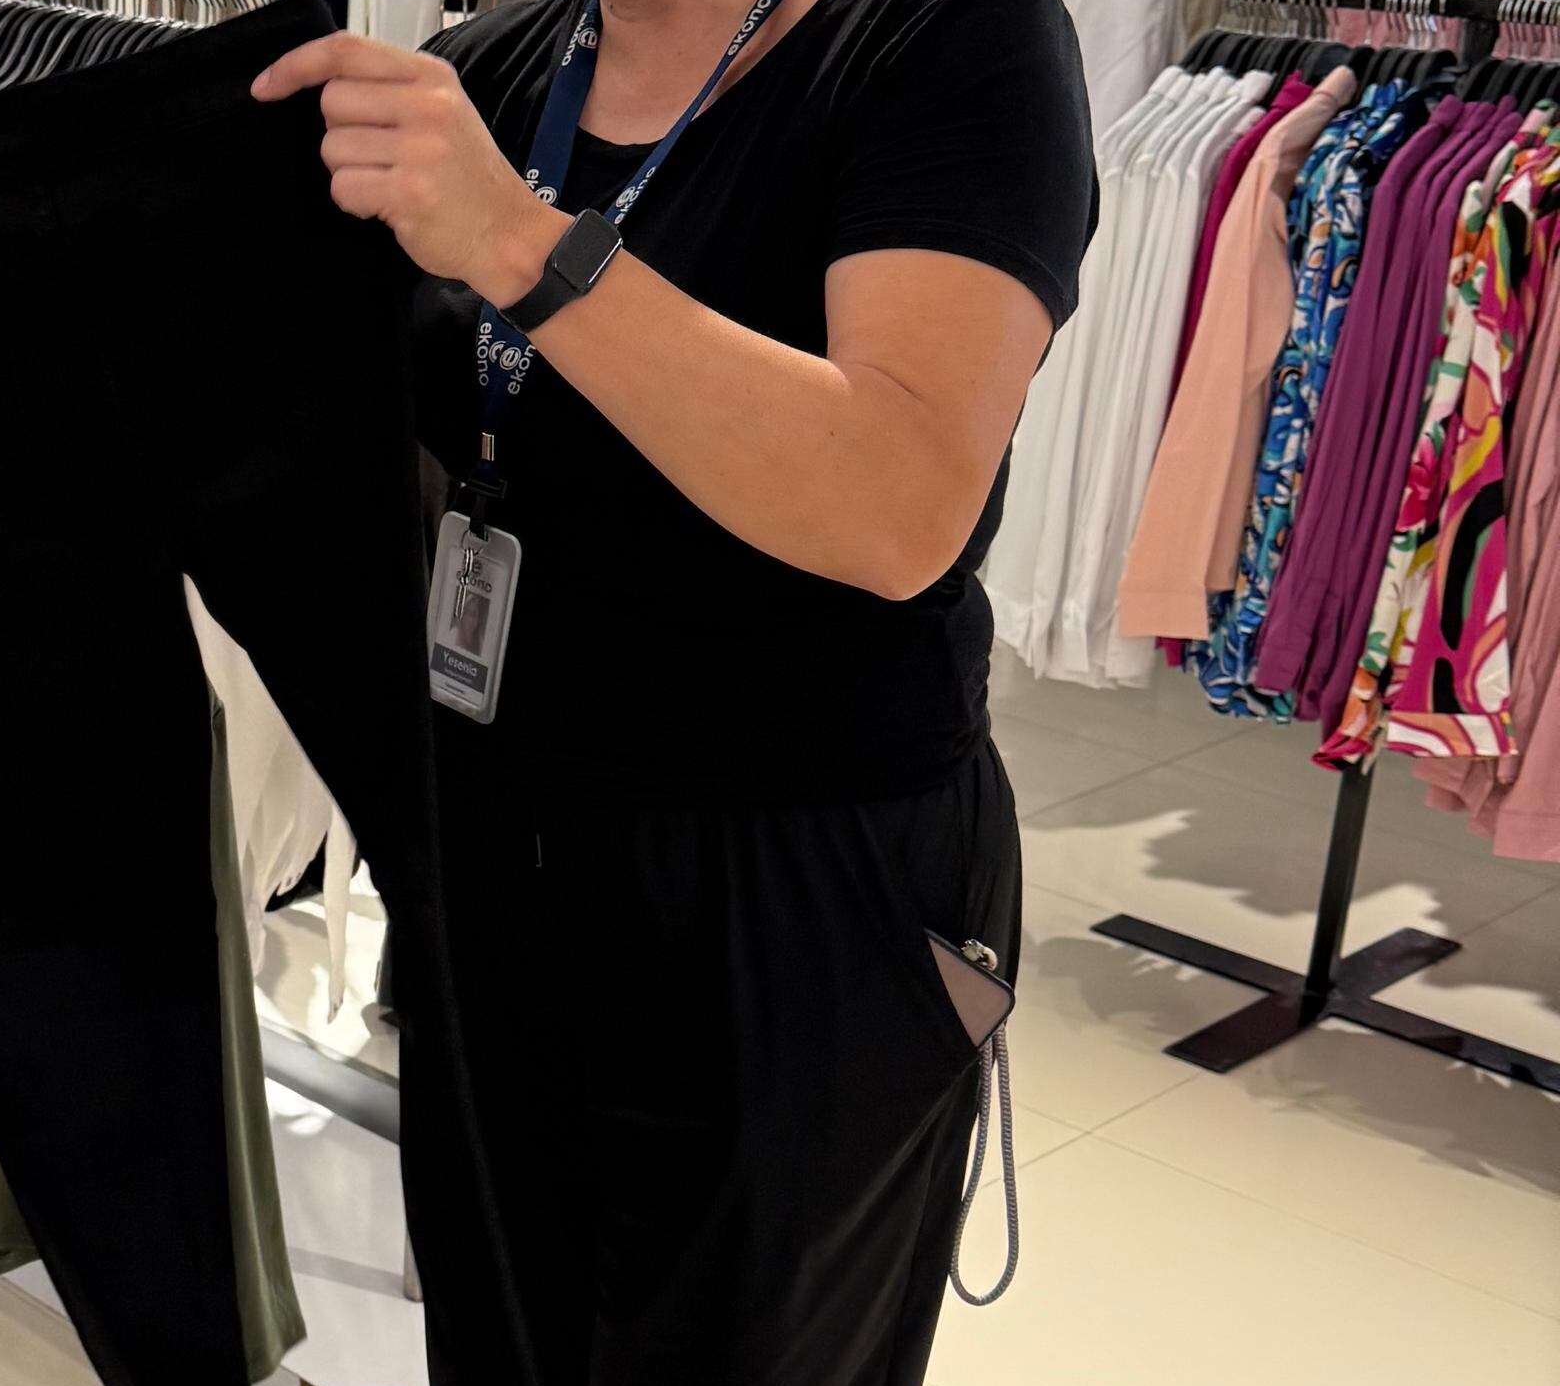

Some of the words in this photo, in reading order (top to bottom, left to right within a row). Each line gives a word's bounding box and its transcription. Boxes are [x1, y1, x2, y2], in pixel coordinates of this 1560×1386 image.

[614, 166, 657, 225] ekono
[476, 322, 492, 387] ekono
[456, 569, 493, 594] eono
